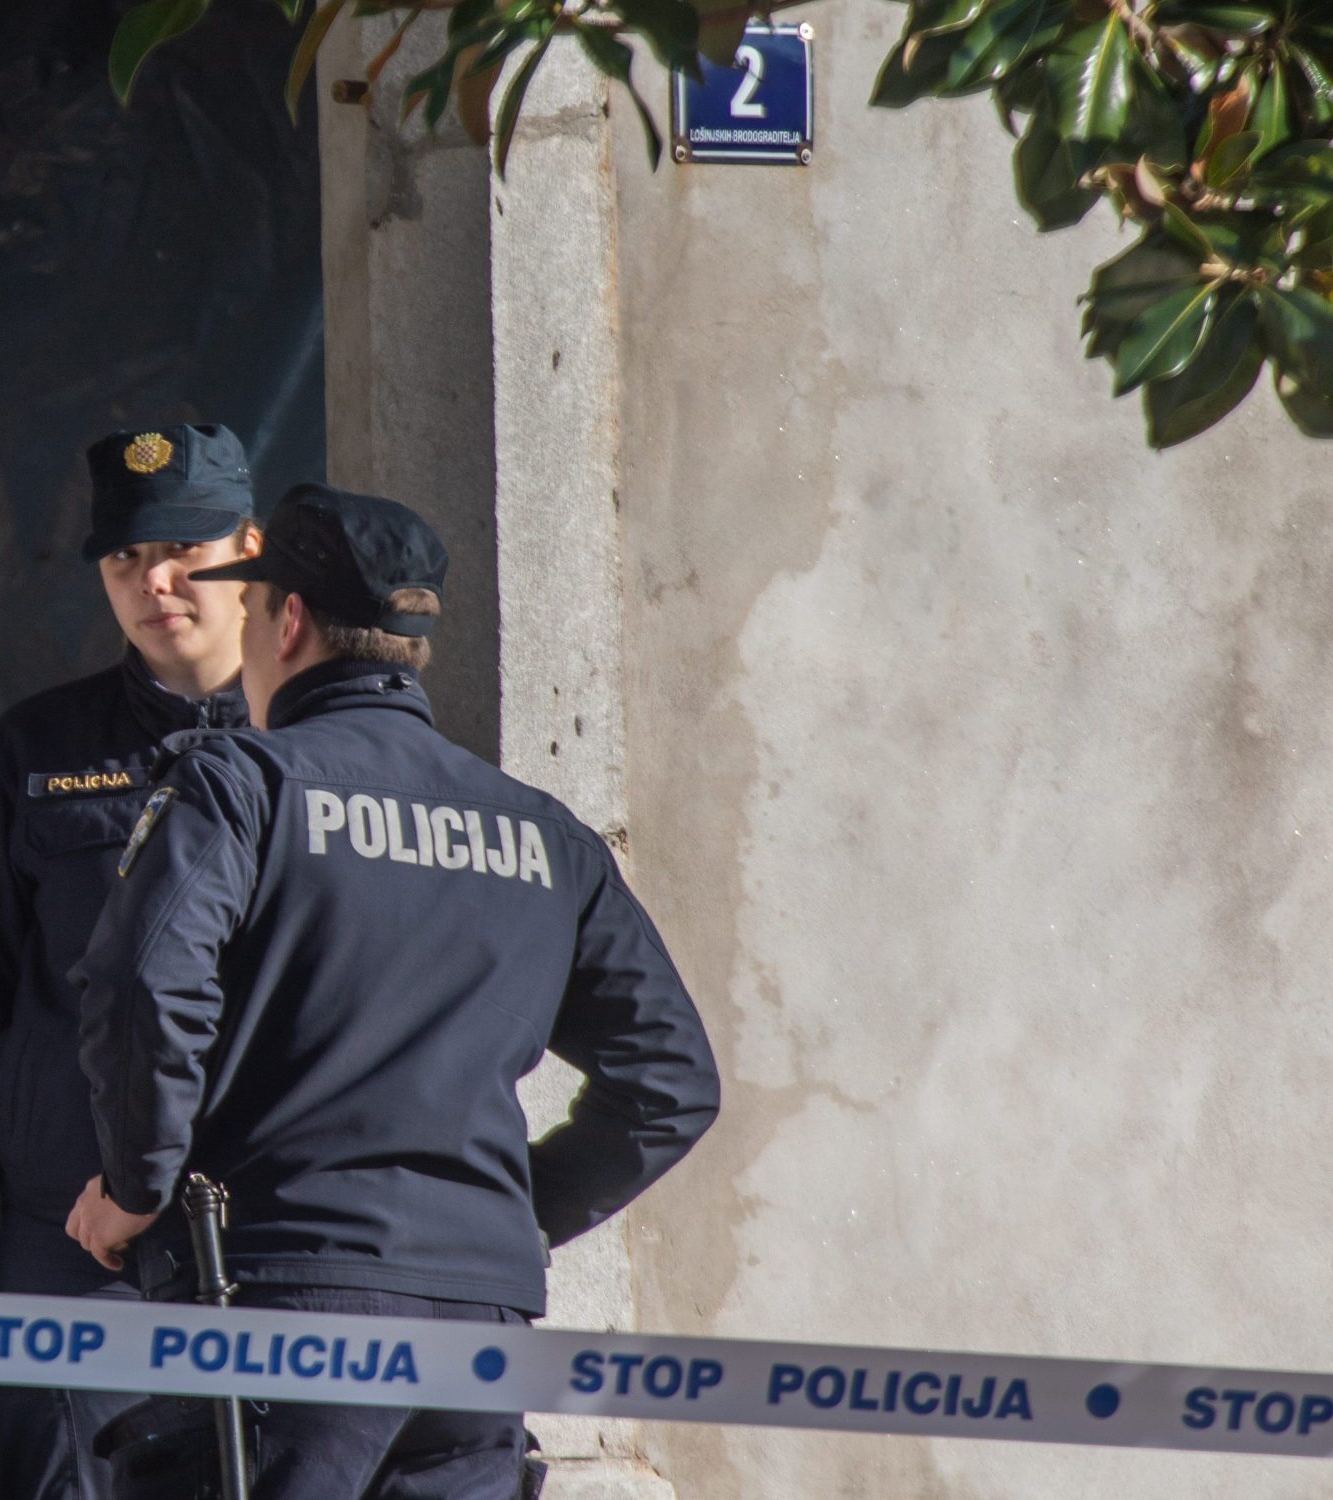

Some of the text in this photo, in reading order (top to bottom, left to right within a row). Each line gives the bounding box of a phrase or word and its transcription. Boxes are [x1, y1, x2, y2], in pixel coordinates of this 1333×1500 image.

[730, 45, 765, 118] 2
[690, 127, 800, 144] LOŠINJSKIH BRODOGRADITELJA
[48, 772, 133, 792] POLICIJA
[305, 789, 552, 889] POLICIJA
[149, 1326, 419, 1384] POLICIJA
[569, 1349, 724, 1400] STOP
[766, 1362, 1034, 1421] POLICIJA
[1181, 1386, 1333, 1435] STOP
